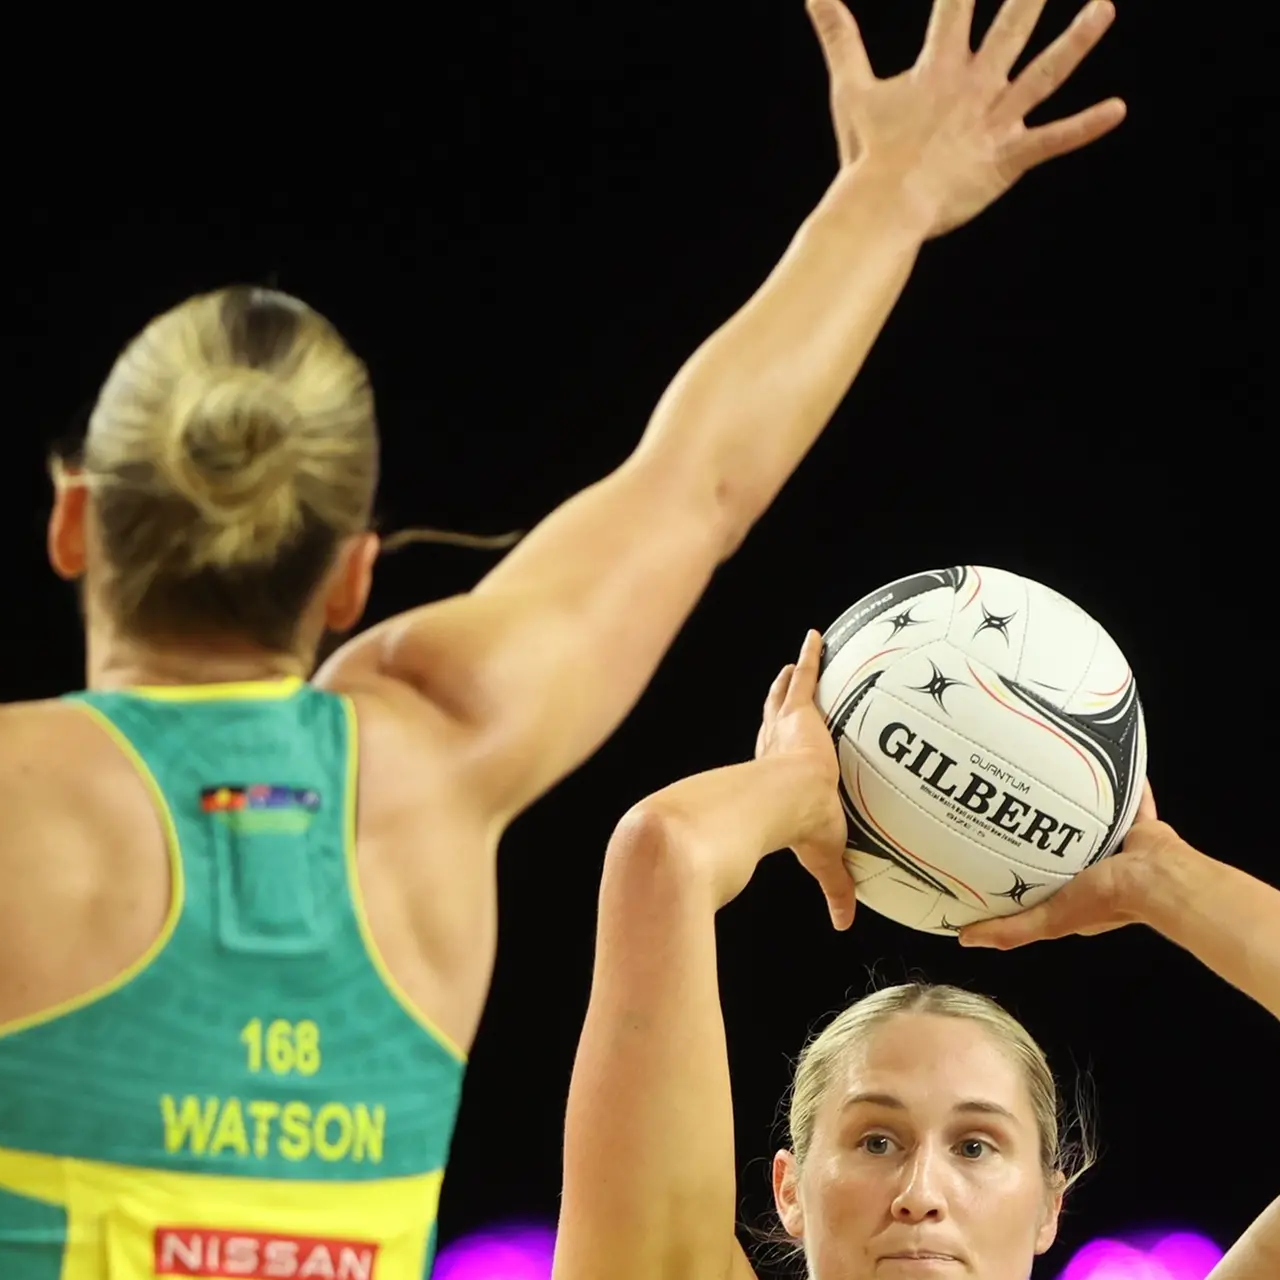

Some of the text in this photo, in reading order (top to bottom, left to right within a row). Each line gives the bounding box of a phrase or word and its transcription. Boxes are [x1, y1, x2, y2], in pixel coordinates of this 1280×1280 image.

[877, 721, 1083, 859] GILBERT
[969, 753, 1031, 795] QUANTUM
[239, 1017, 322, 1077] 168
[160, 1094, 387, 1163] WATSON
